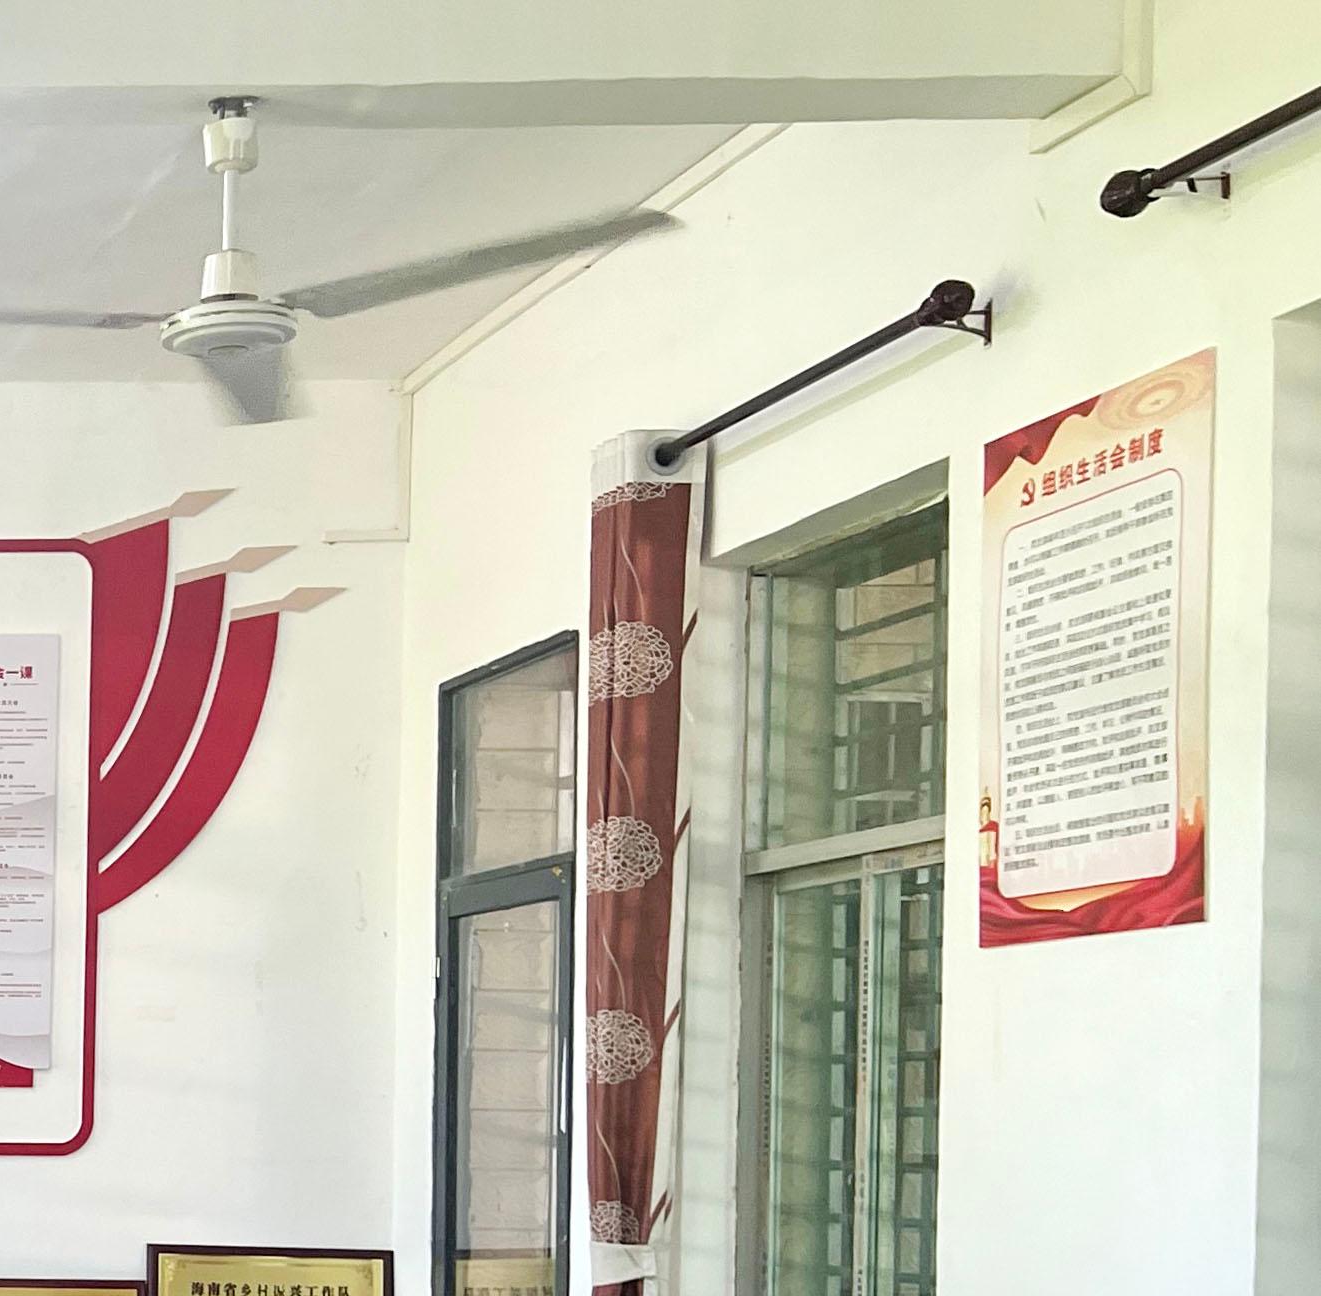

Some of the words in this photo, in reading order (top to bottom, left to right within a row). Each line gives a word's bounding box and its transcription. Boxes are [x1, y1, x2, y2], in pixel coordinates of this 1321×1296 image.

[1041, 426, 1165, 497] 组织生活会制度
